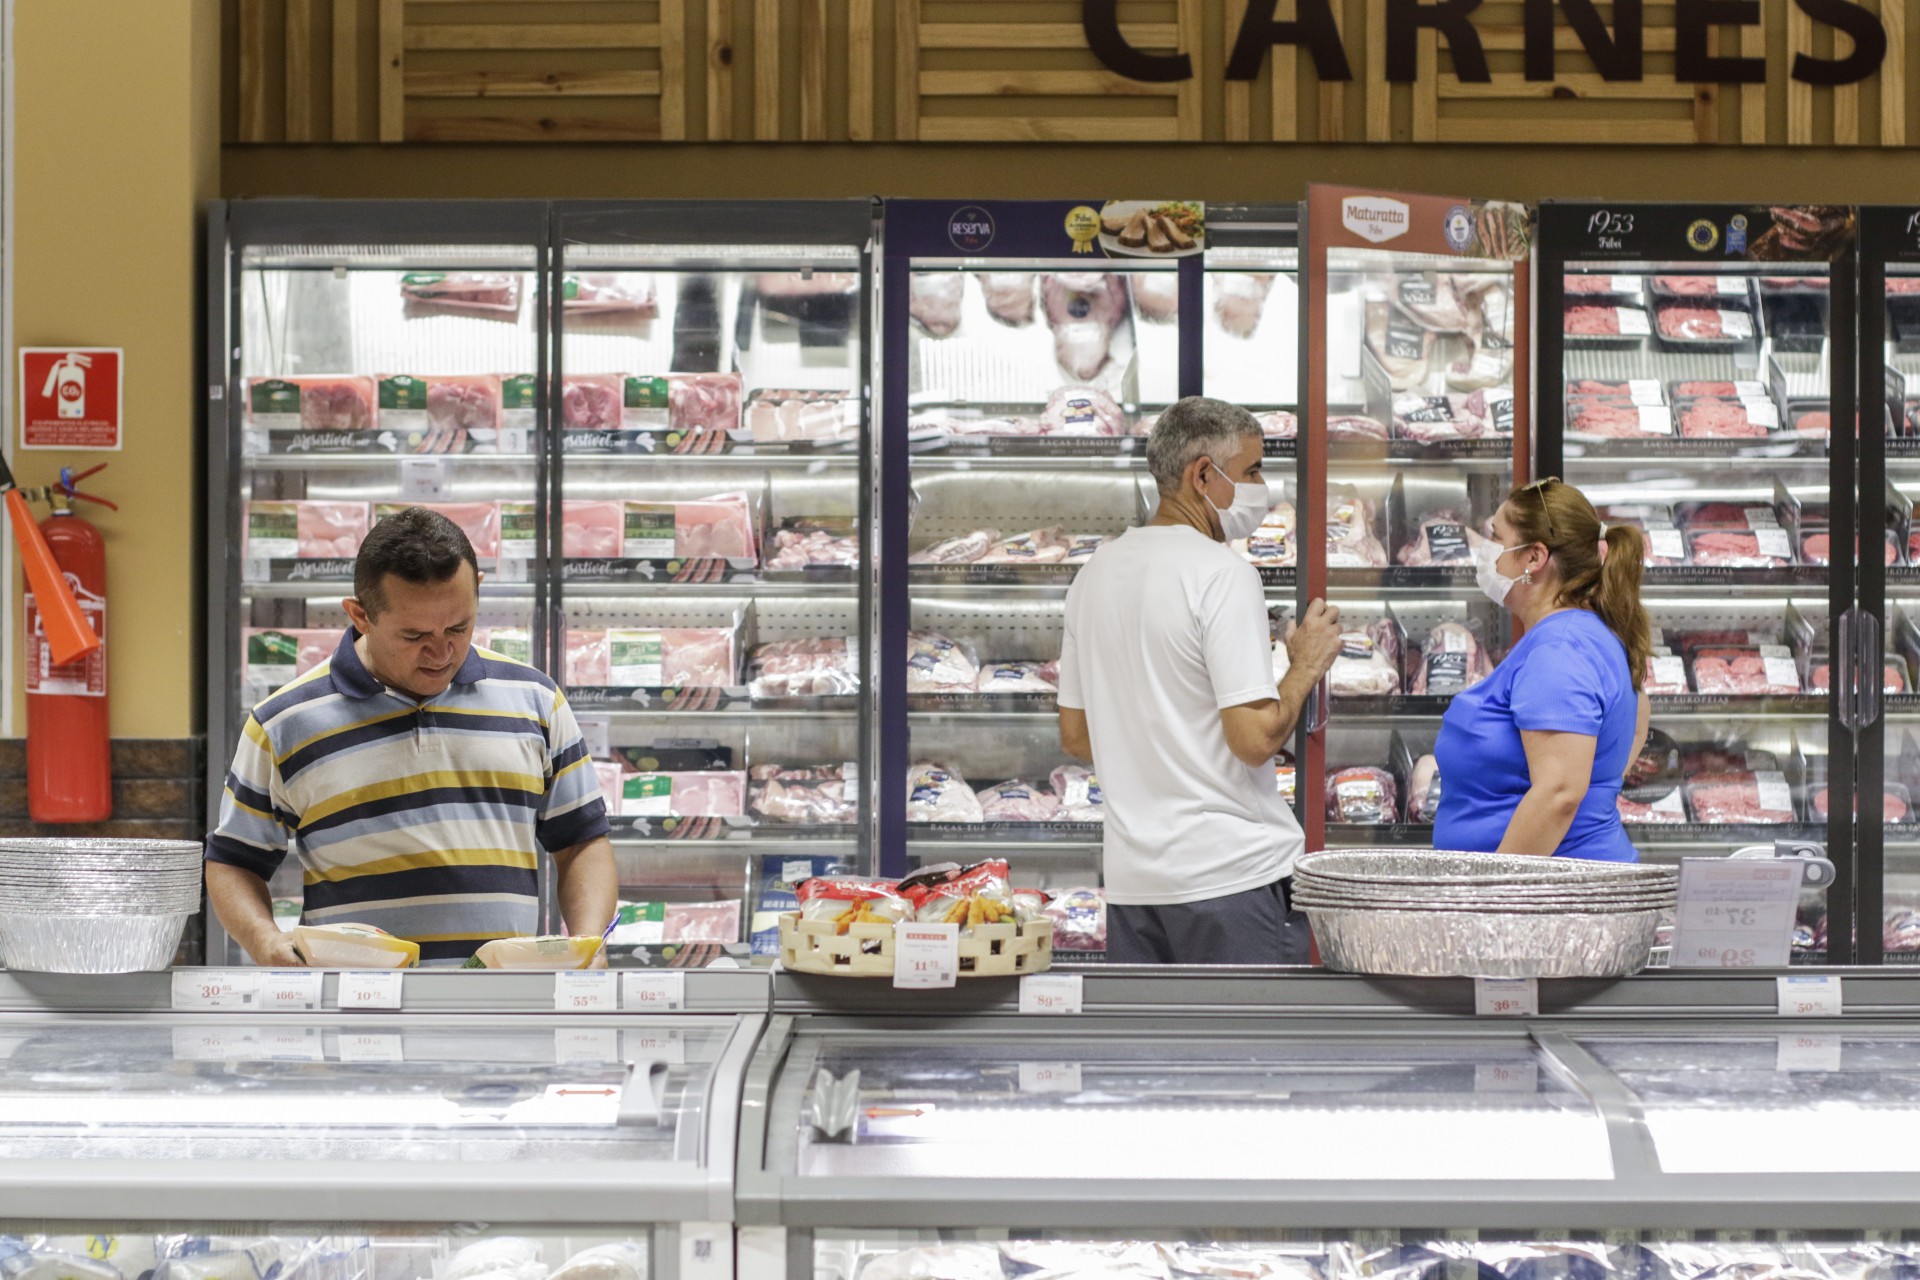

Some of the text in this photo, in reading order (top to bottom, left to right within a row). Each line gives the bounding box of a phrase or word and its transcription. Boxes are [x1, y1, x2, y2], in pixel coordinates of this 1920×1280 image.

[1083, 0, 1889, 84] CARNES
[1346, 204, 1405, 224] Maturatta
[1588, 209, 1634, 234] 1953
